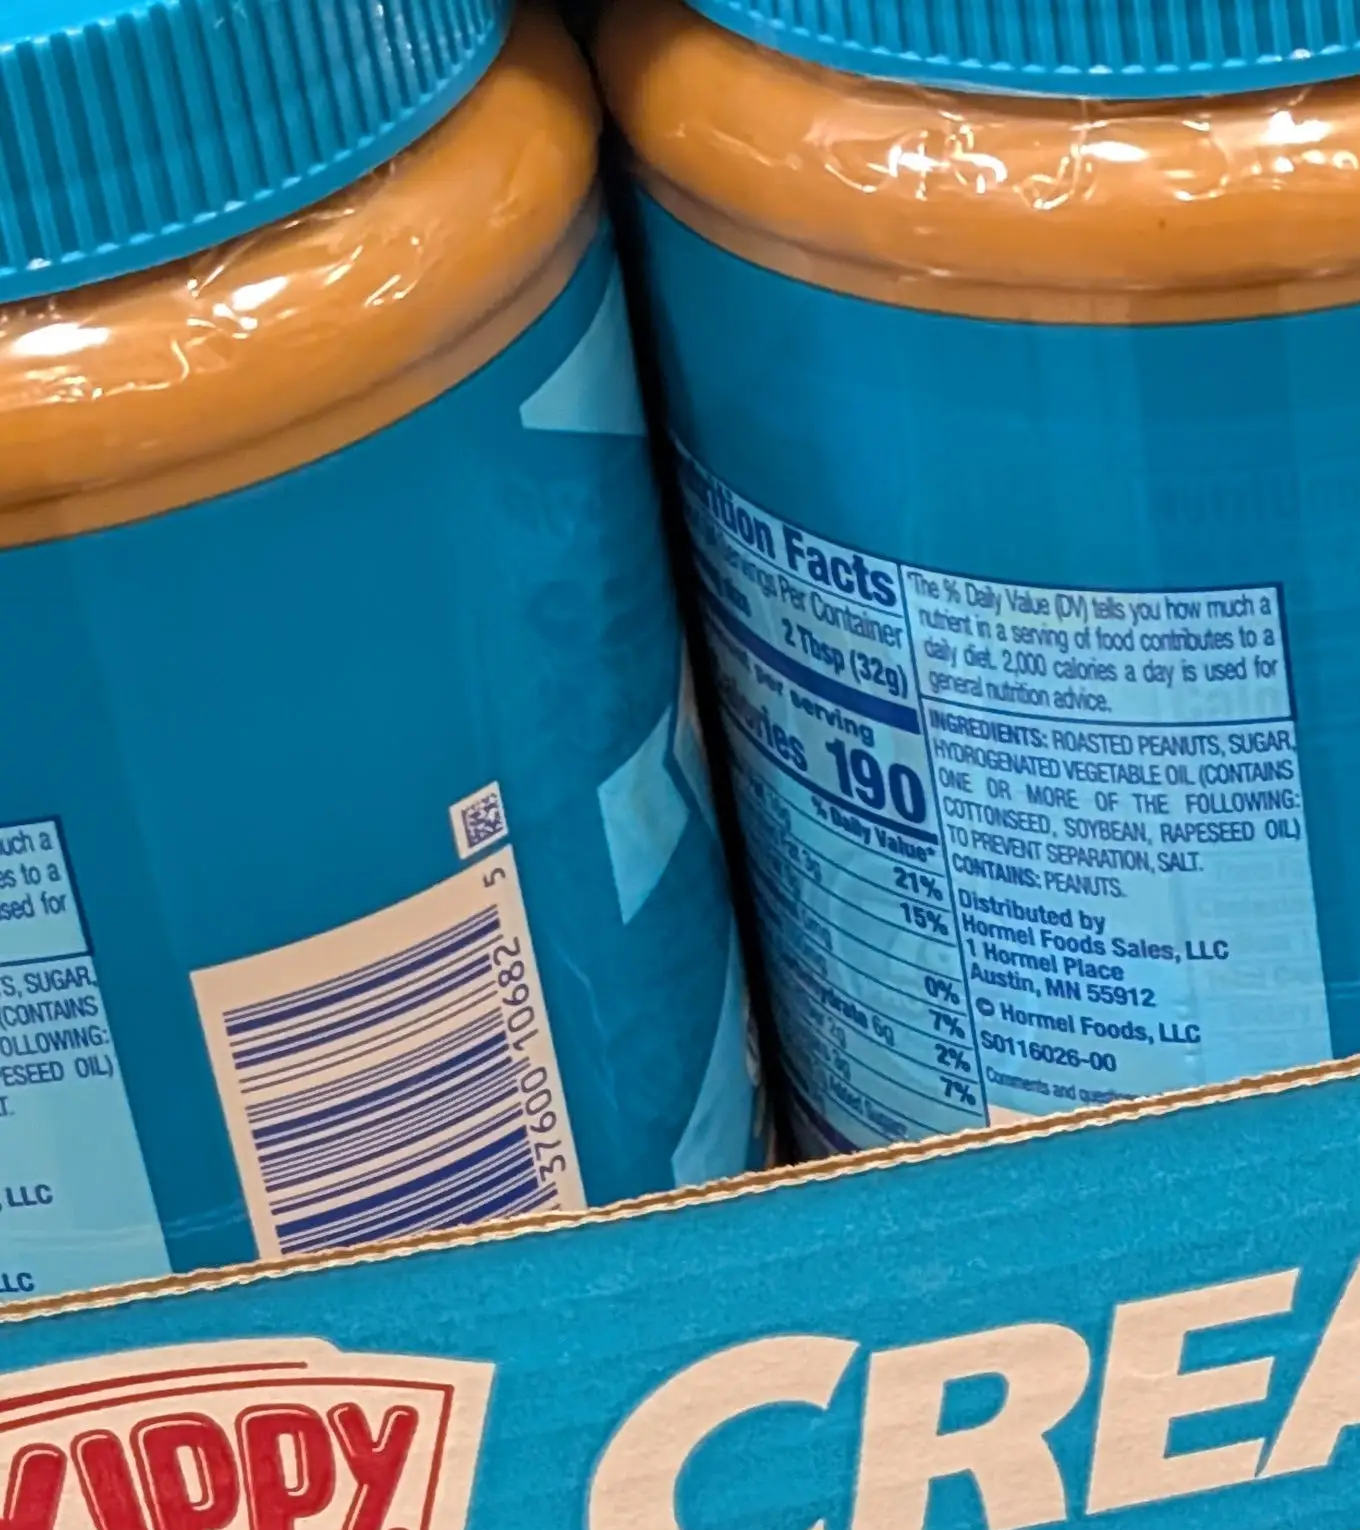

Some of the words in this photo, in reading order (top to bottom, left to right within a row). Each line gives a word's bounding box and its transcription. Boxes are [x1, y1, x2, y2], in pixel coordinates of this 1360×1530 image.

[782, 522, 896, 606] Facts
[826, 739, 926, 823] 190
[962, 912, 1034, 946] Hormel
[1040, 929, 1105, 955] Foods
[1112, 938, 1181, 963] Sales,
[1186, 940, 1229, 961] LLC
[493, 937, 536, 1050] 10682
[971, 962, 1041, 997] Austin,
[1045, 979, 1080, 1000] MN
[1087, 984, 1156, 1007] 55912
[519, 1066, 565, 1182] 37600
